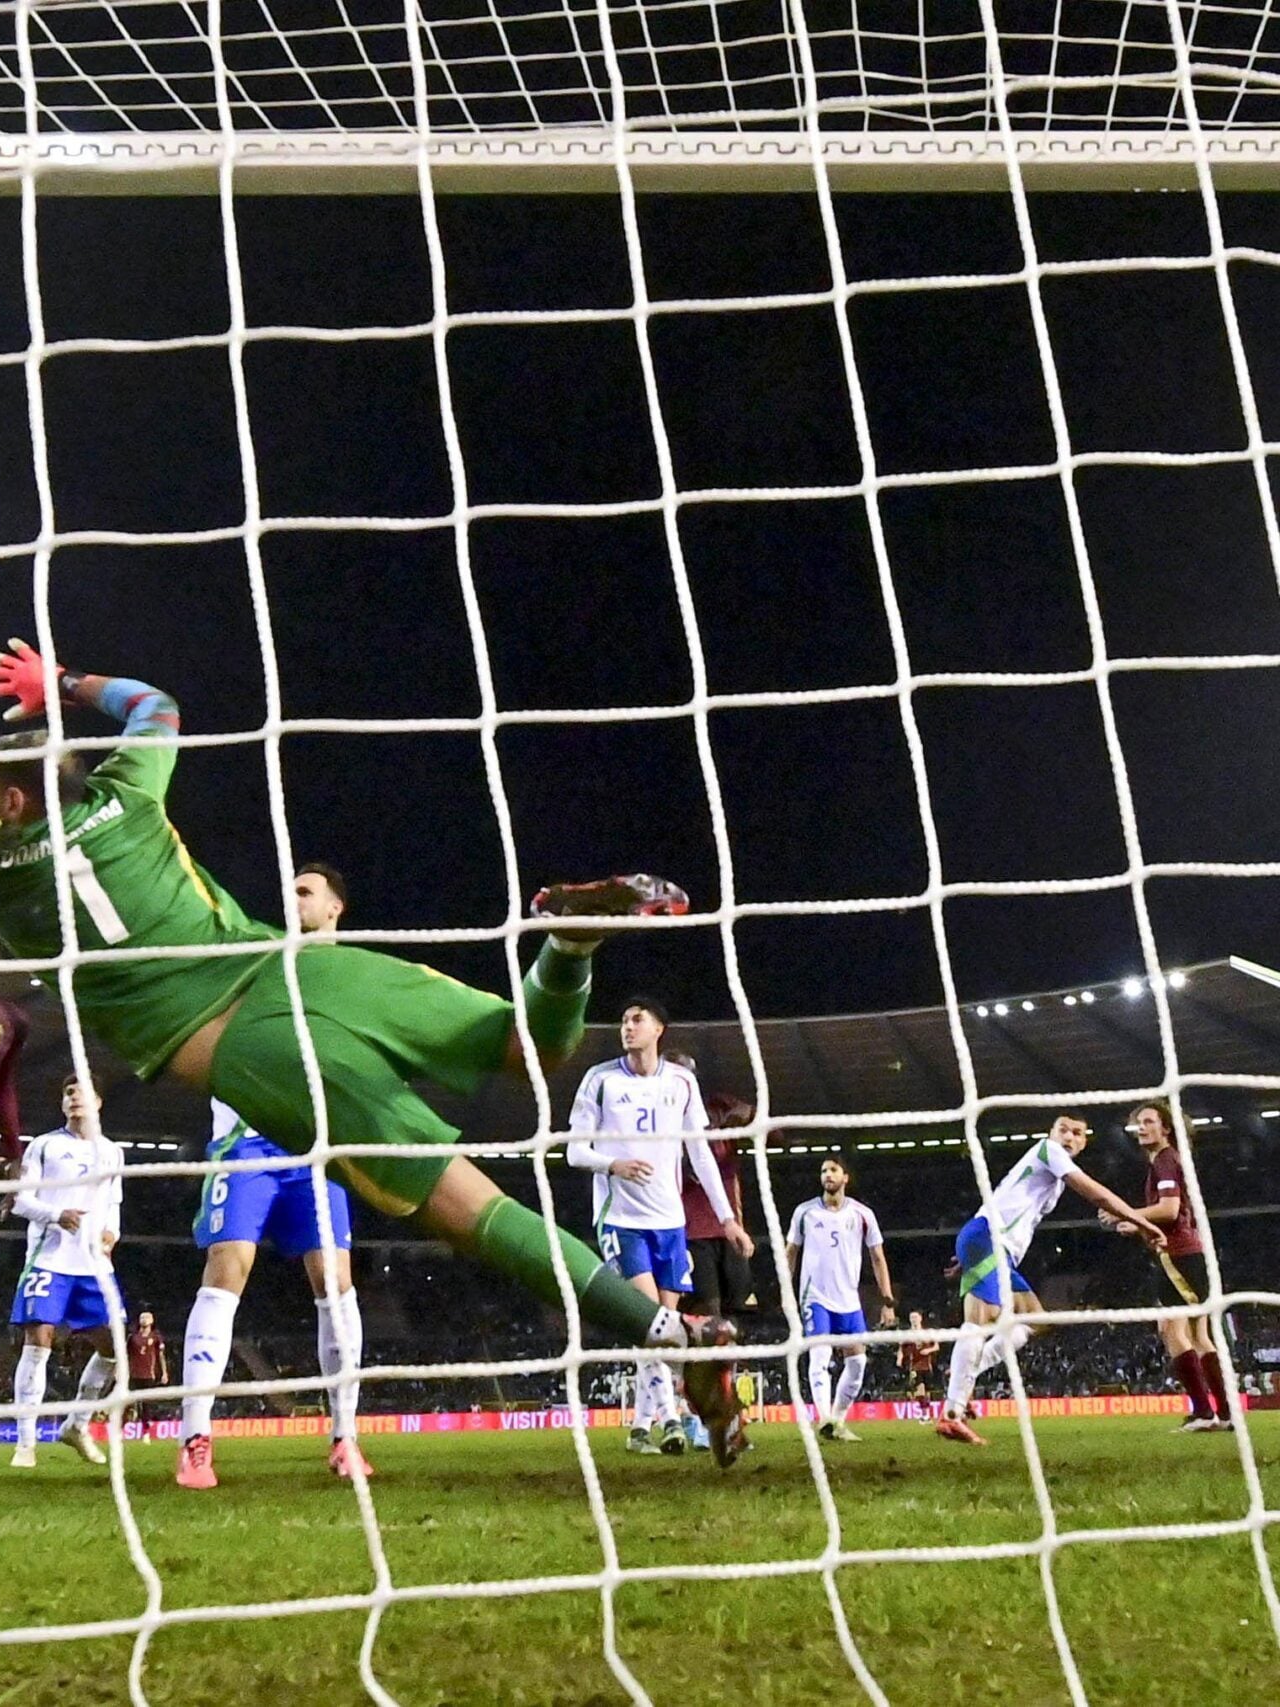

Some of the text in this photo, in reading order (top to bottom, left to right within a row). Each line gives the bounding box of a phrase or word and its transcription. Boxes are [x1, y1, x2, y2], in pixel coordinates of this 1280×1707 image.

[64, 844, 131, 945] 1
[636, 1108, 656, 1133] 21
[211, 1172, 230, 1206] 6
[602, 1229, 622, 1263] 21
[830, 1231, 839, 1248] 5
[23, 1271, 53, 1298] 22
[987, 1399, 1065, 1417] BELIAN
[1072, 1398, 1106, 1415] RED
[1110, 1395, 1185, 1414] COURTS
[157, 1421, 183, 1438] OU
[212, 1418, 278, 1437] ELGIAN
[283, 1417, 318, 1435] RED
[402, 1414, 421, 1432] IN
[500, 1411, 548, 1430] VISIT
